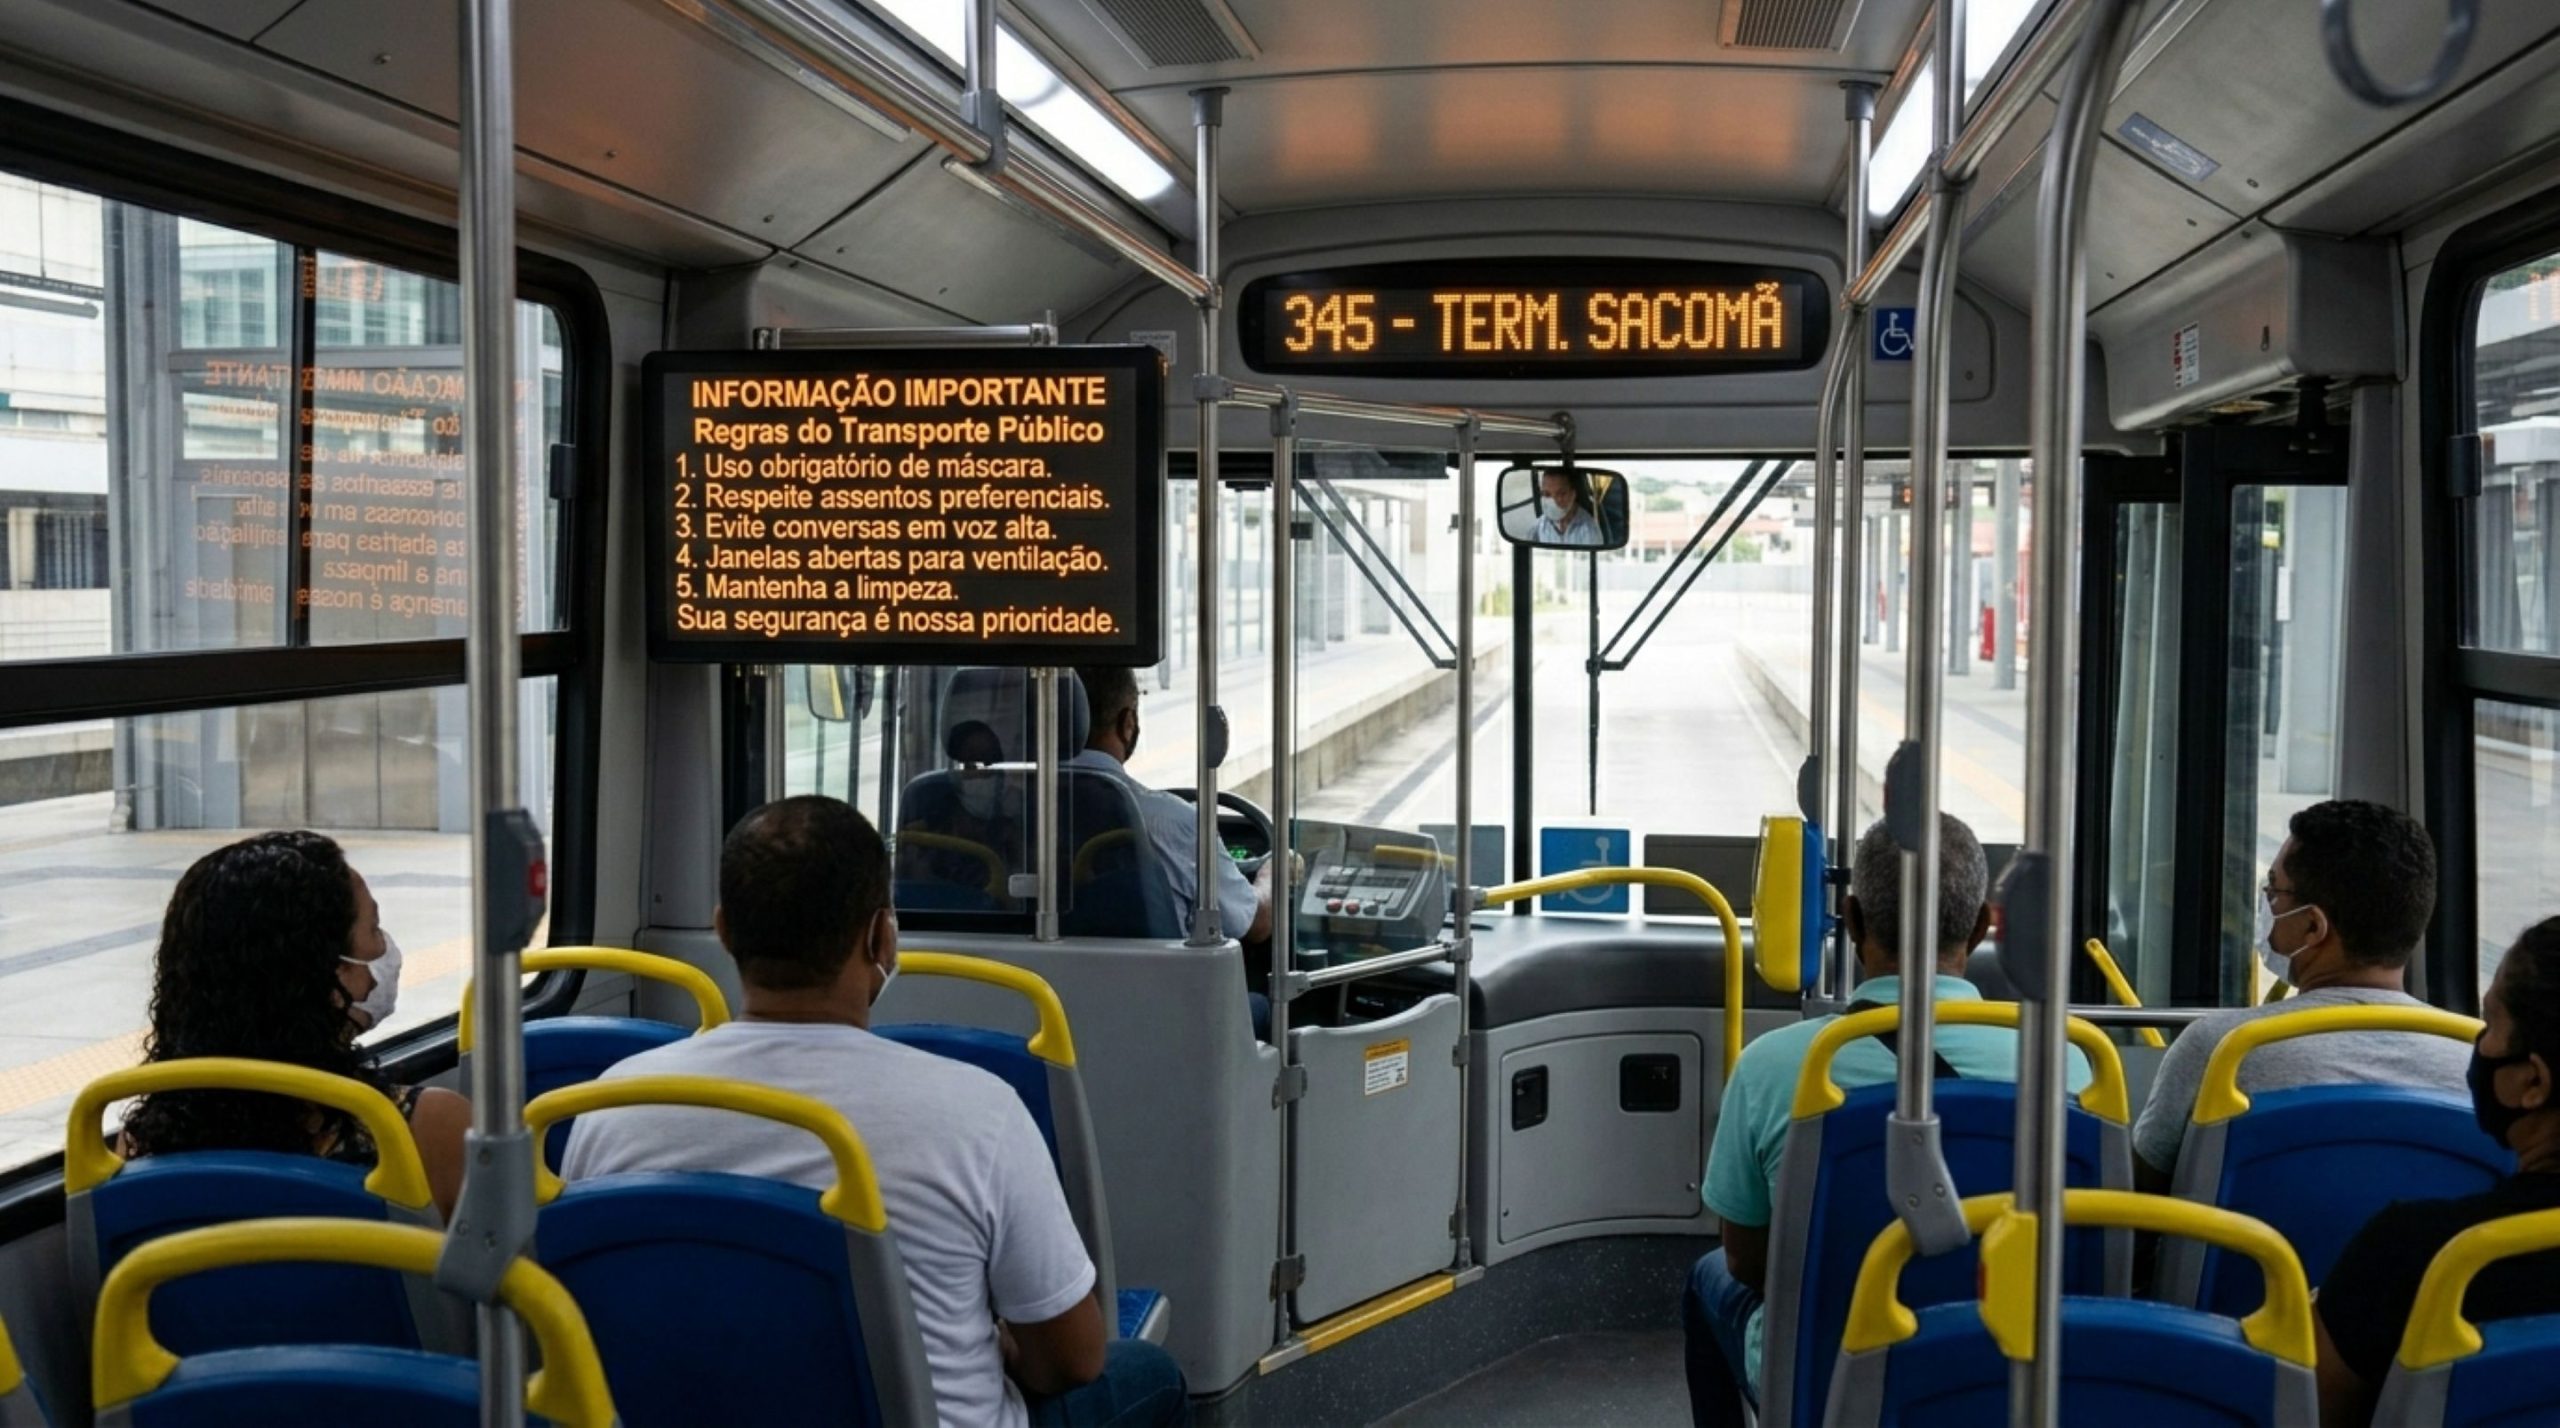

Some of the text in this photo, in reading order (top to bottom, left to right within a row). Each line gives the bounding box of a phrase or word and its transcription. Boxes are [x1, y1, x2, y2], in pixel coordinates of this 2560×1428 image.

[1284, 292, 1376, 352] 345
[1432, 292, 1569, 352] TERM.
[1587, 281, 1783, 351] SACOMÃ
[692, 373, 1107, 413] INFORMAÇÃO IMPORTANTE
[694, 414, 1105, 451] Regras do Transporte Público
[675, 451, 1053, 484] 1. Uso obrigatório de máscara.
[674, 482, 1111, 515] 2. Respeite assentos preferenciais.
[674, 512, 1058, 540] 3. Evite conversas em voz alta.
[674, 542, 1109, 578] 4. Janelas abertas para ventilação.
[675, 572, 960, 607] 5. Mantenha a limpeza.
[677, 602, 1121, 640] Sua segurança é nossa prioridade.
